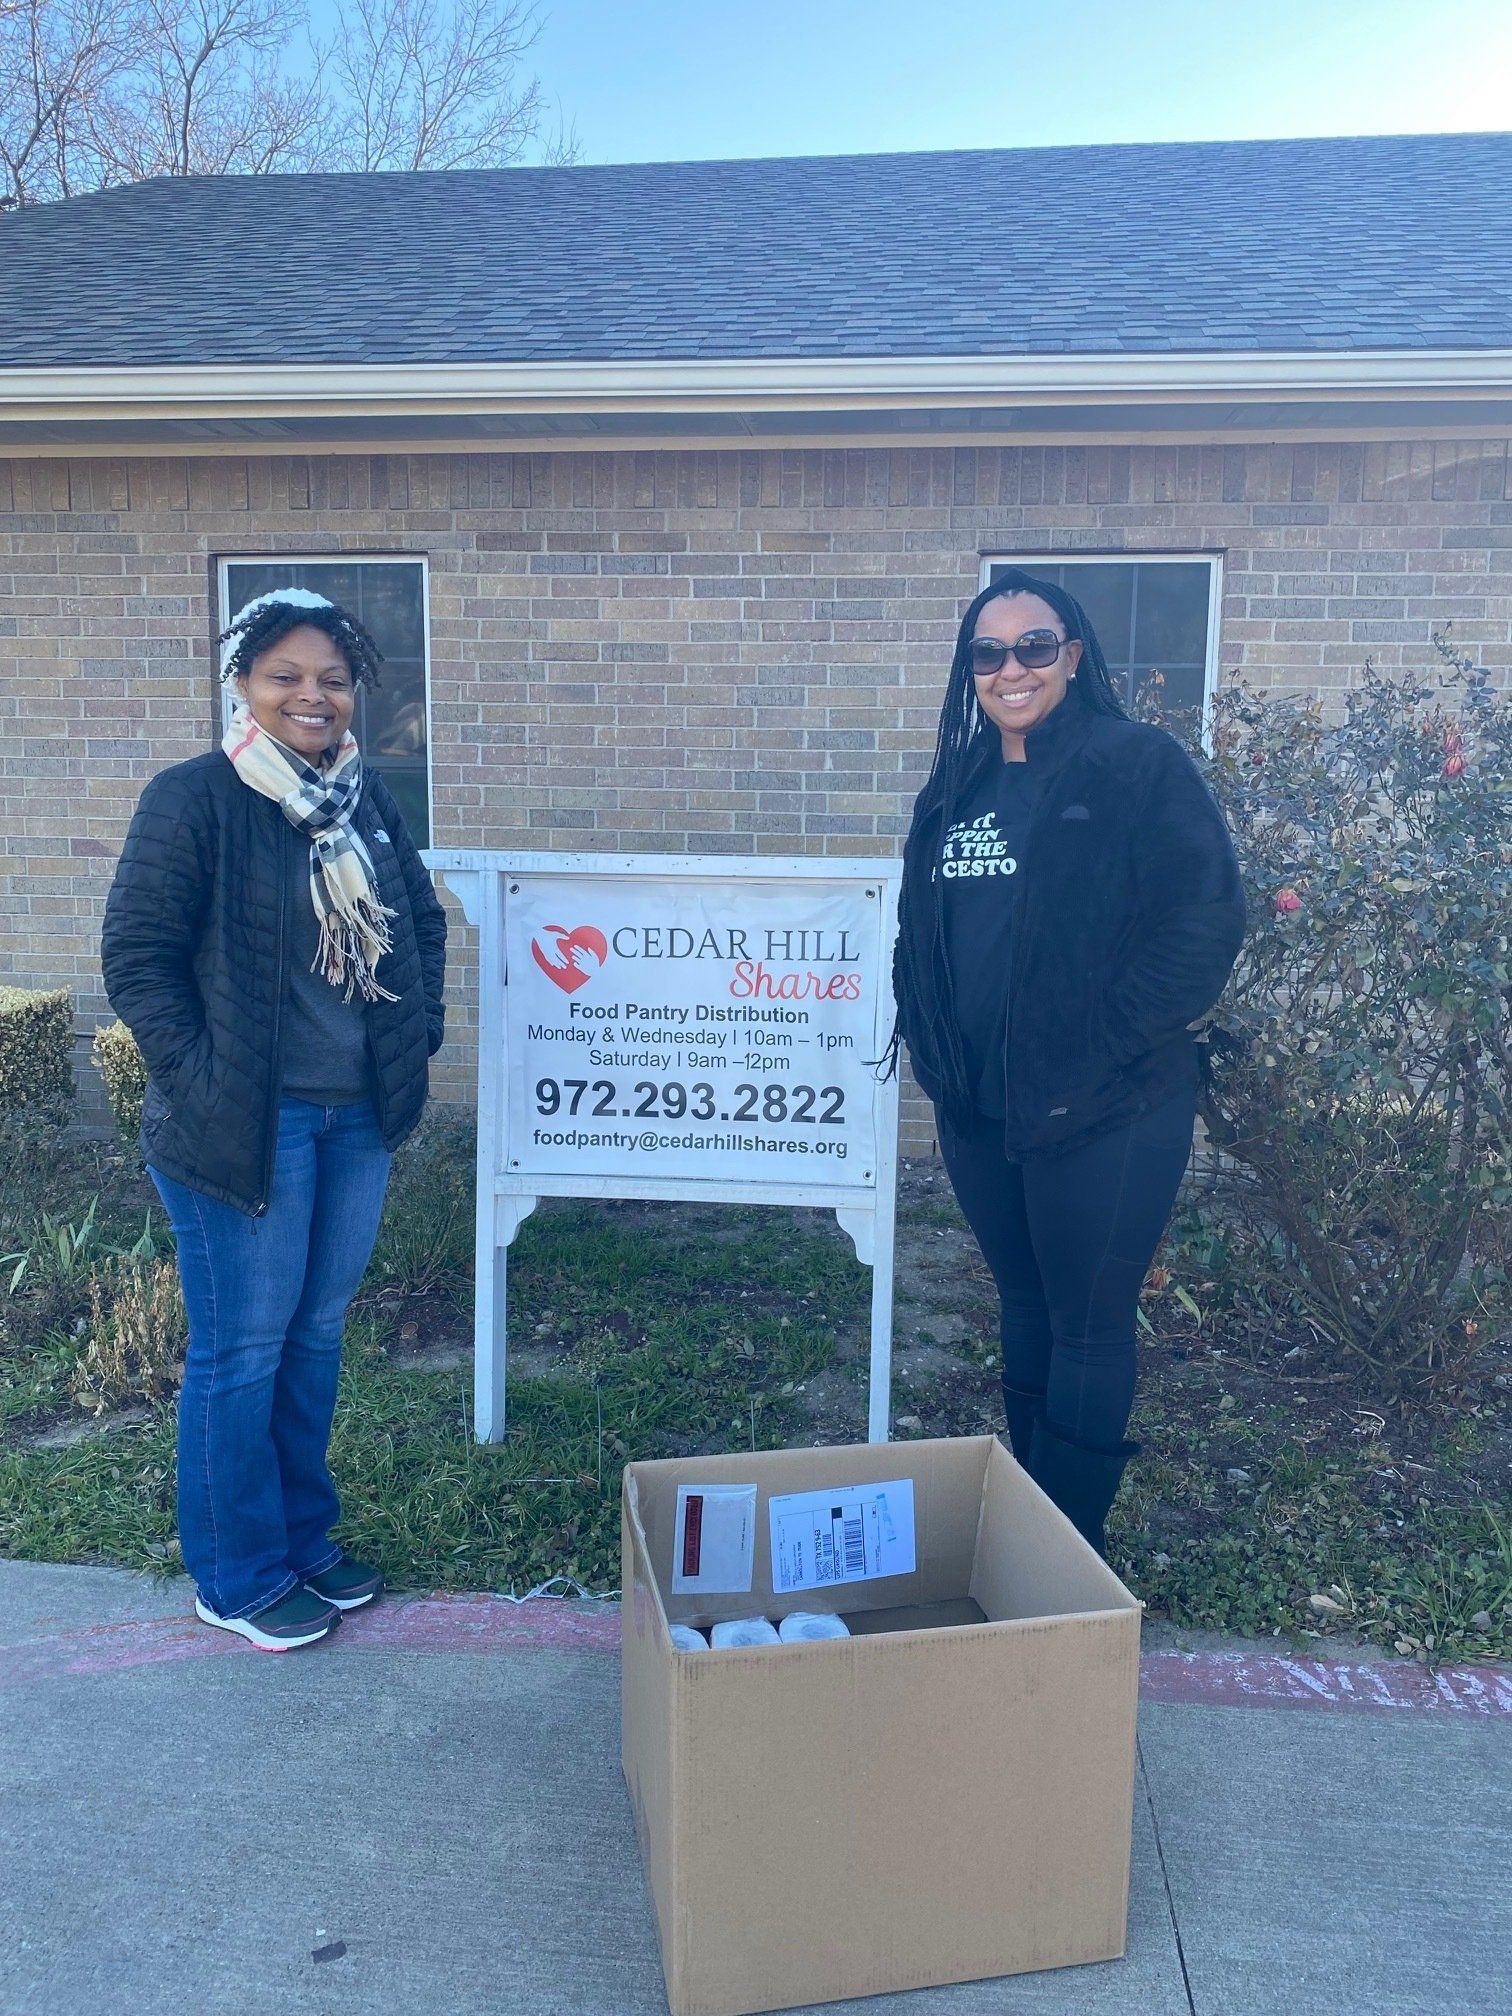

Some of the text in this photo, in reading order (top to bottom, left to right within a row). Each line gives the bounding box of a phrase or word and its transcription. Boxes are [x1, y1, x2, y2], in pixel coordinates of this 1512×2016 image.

[946, 828, 1003, 842] PPIN
[961, 841, 1008, 858] THE
[931, 857, 1017, 882] CESTO
[612, 926, 860, 962] CEDAR HILL
[729, 960, 862, 1000] Shares
[569, 1002, 809, 1025] Food Pantry Distribution
[528, 1025, 597, 1045] Monday
[602, 1026, 615, 1043] &
[621, 1027, 727, 1048] Wednesday
[745, 1030, 793, 1047] 10am
[817, 1032, 854, 1051] 1pm
[589, 1049, 671, 1071] Saturday
[687, 1052, 727, 1068] 9am
[535, 1077, 846, 1124] 972.293.2822
[533, 1129, 848, 1159] foodpantry@cedarhillshares.org
